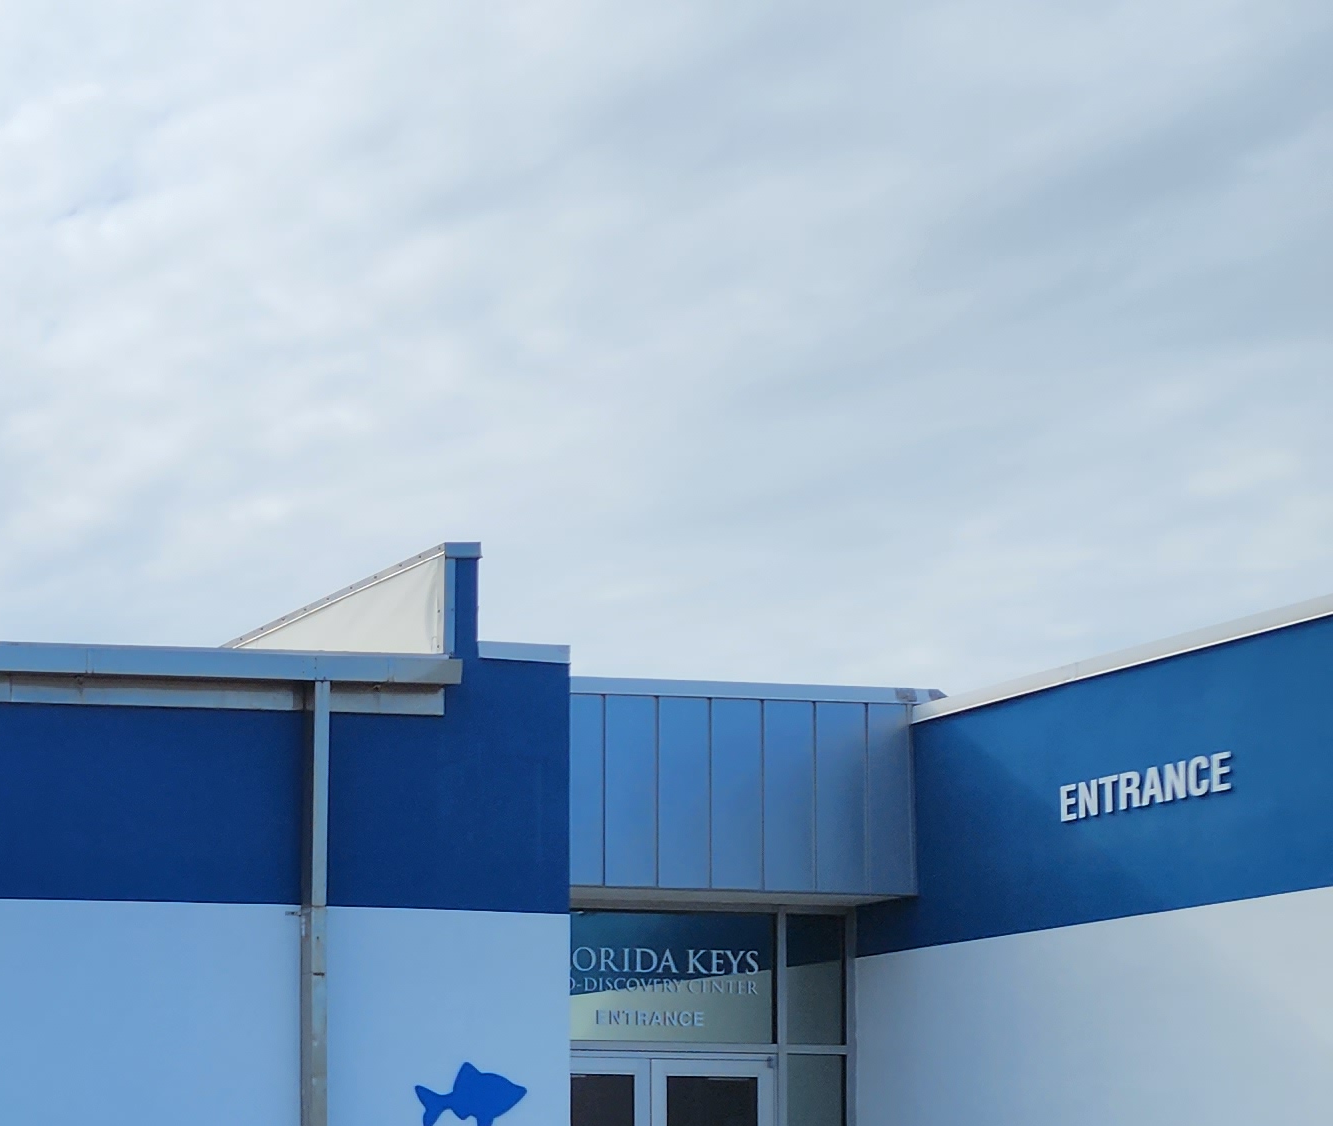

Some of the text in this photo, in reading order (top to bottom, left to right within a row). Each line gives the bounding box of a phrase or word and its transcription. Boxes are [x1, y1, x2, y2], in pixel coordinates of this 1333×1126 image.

[1059, 751, 1232, 822] ENTRANCE
[570, 946, 760, 976] ORIDA KEYS
[688, 979, 760, 996] CENTER
[595, 1009, 705, 1028] ENTRANCE
